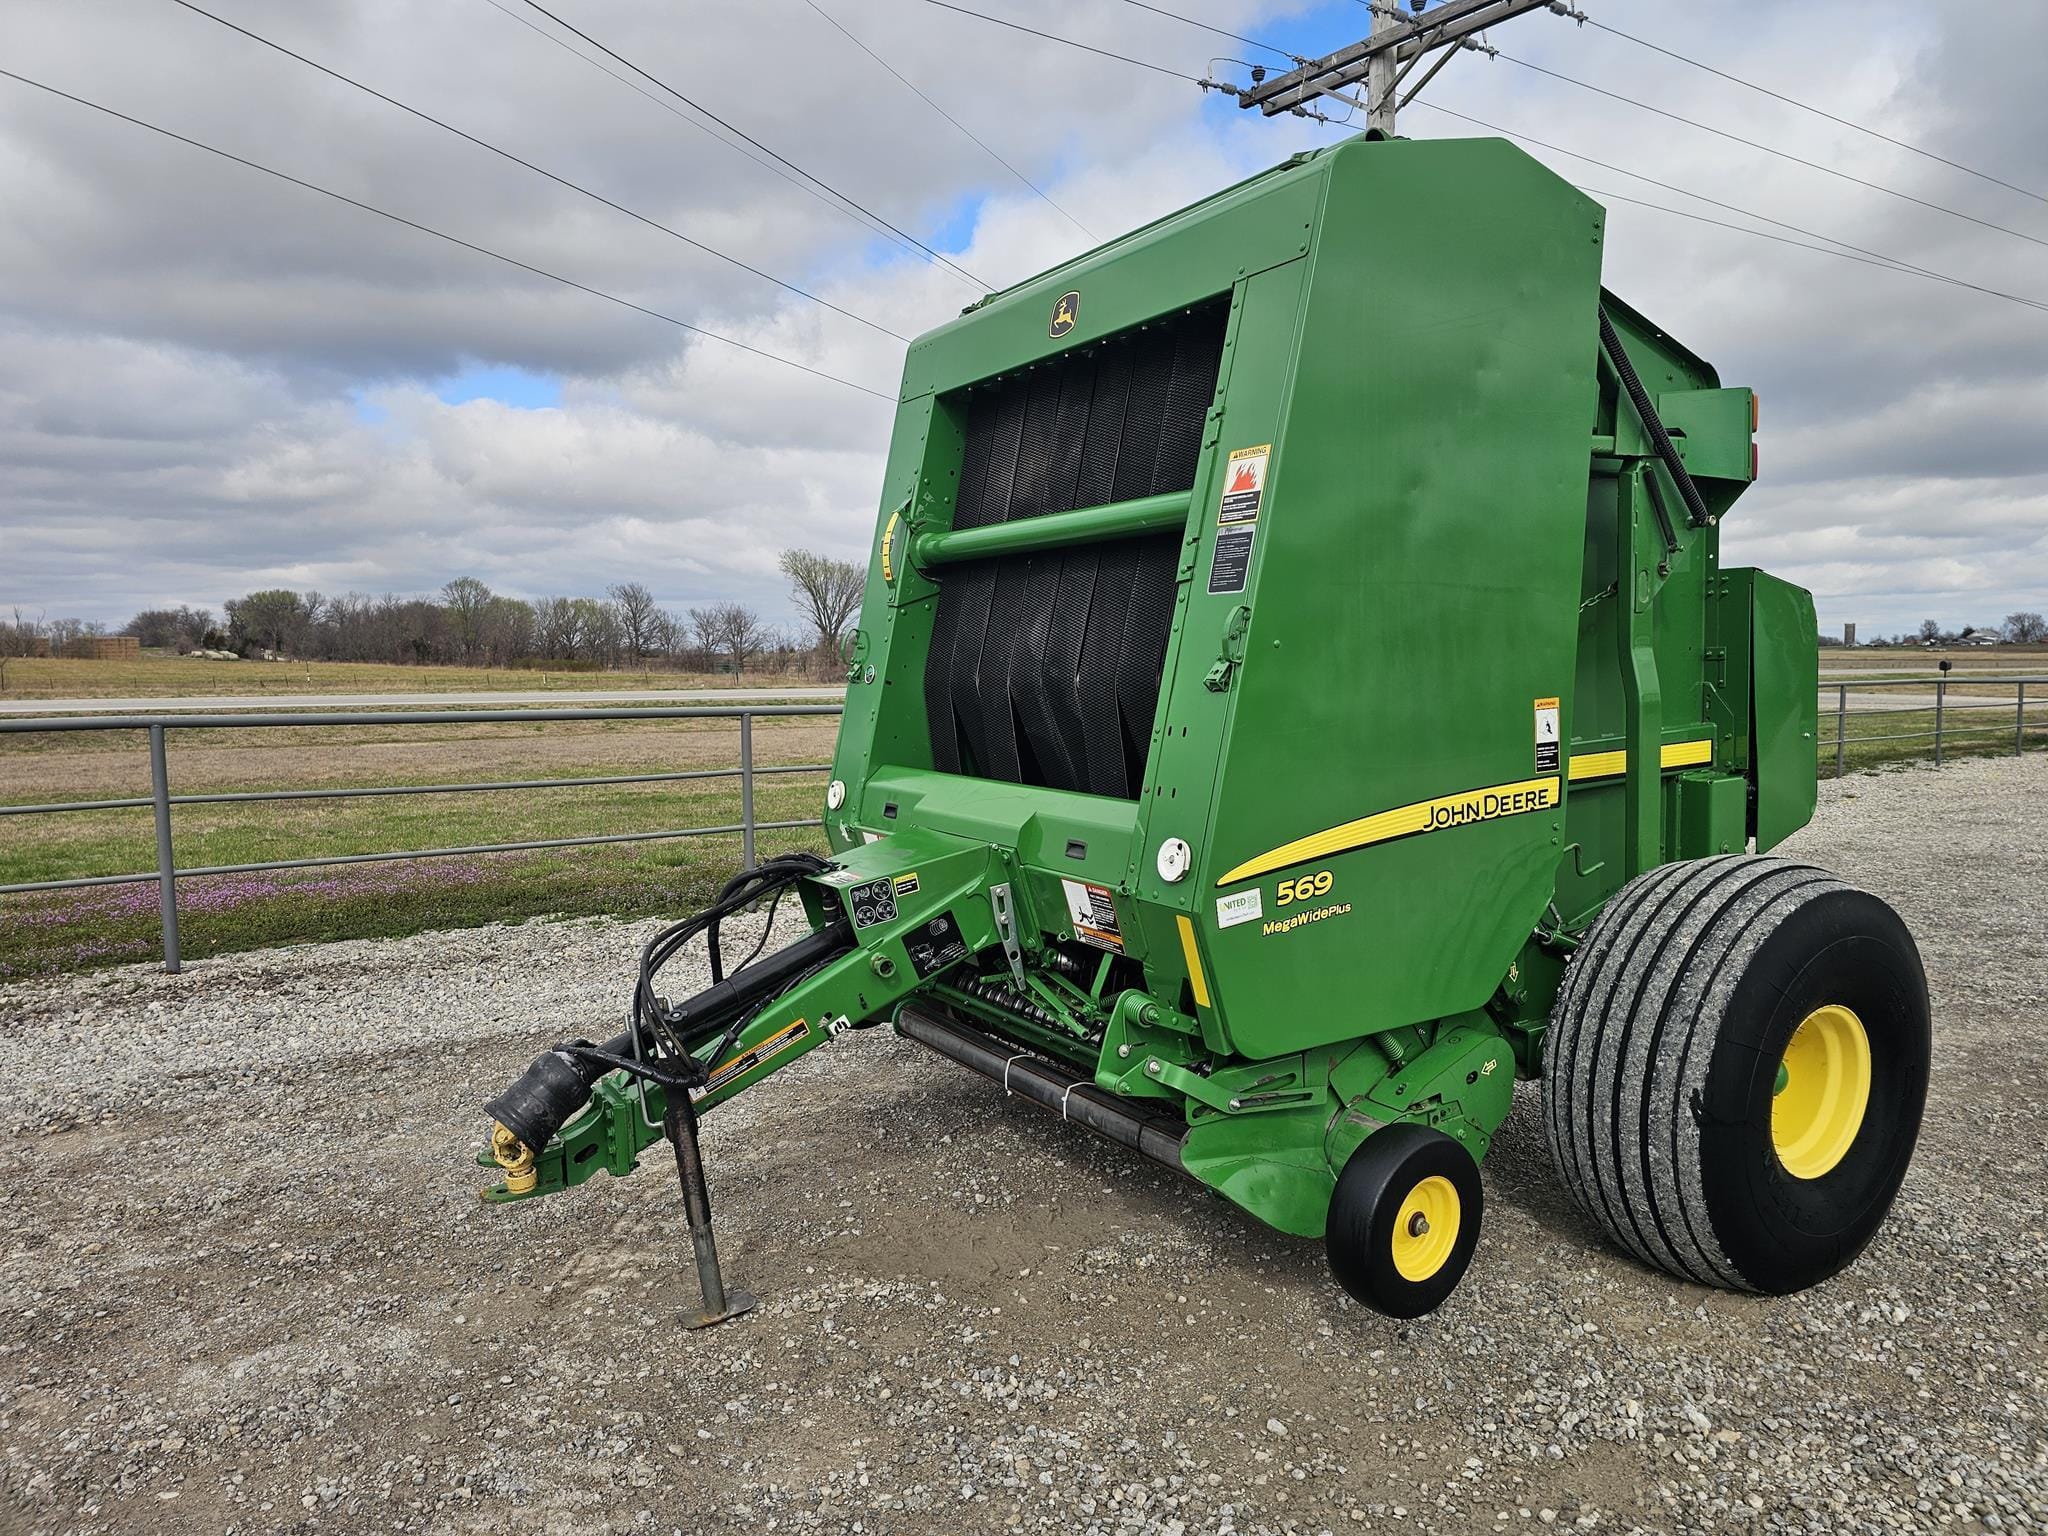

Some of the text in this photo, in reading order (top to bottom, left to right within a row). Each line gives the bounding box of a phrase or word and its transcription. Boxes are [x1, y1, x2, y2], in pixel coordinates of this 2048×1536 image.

[1238, 446, 1267, 458] WARNING
[1423, 789, 1549, 829] JOHN DEERE
[1277, 870, 1334, 907] 569
[1262, 903, 1352, 936] MegaWidePlus
